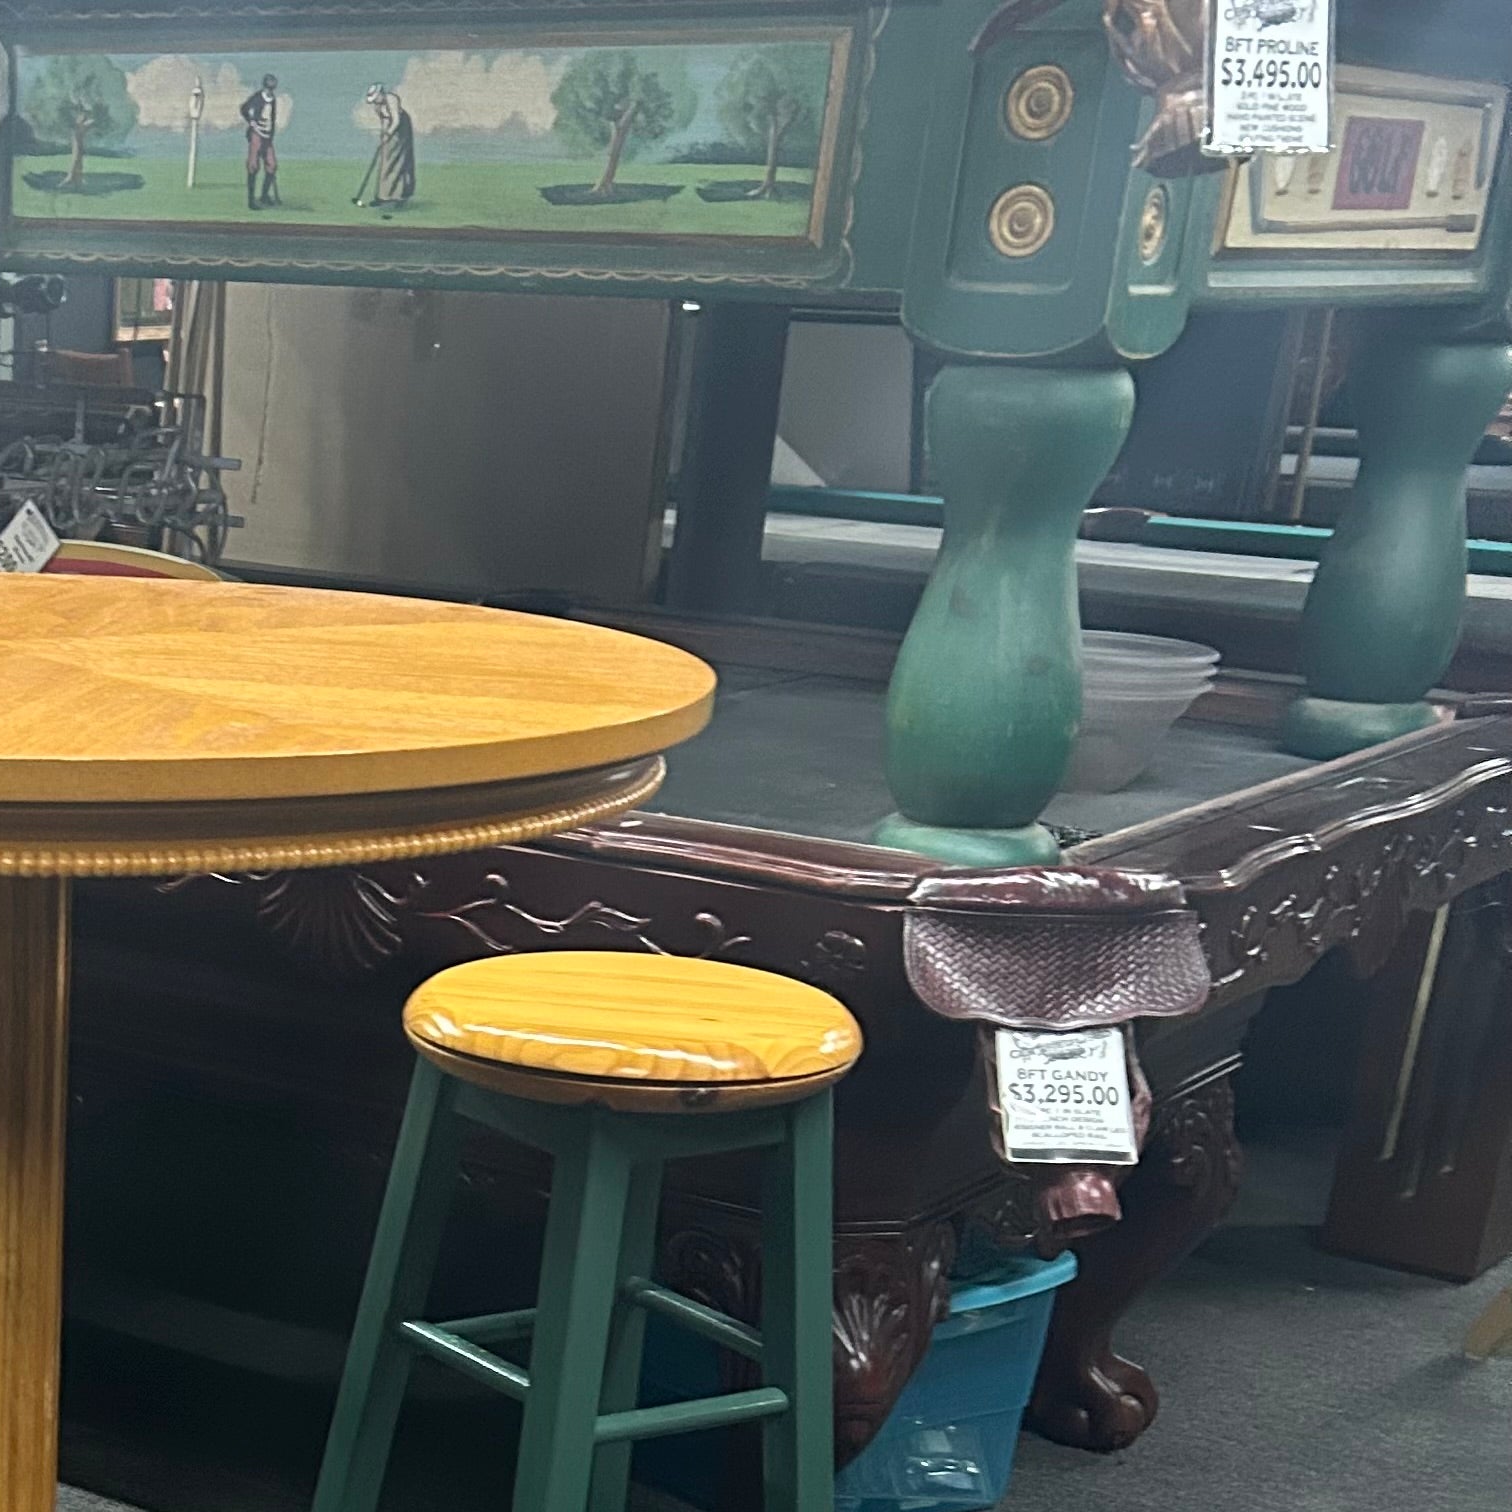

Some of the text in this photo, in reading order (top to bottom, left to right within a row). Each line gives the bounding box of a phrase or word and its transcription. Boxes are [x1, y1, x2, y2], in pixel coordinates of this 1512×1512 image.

[1257, 38, 1319, 56] PROLINE
[1221, 57, 1322, 88] $3,495.00
[1017, 1068, 1109, 1083] 8FT GANDY
[1008, 1082, 1120, 1105] $3,295.00
